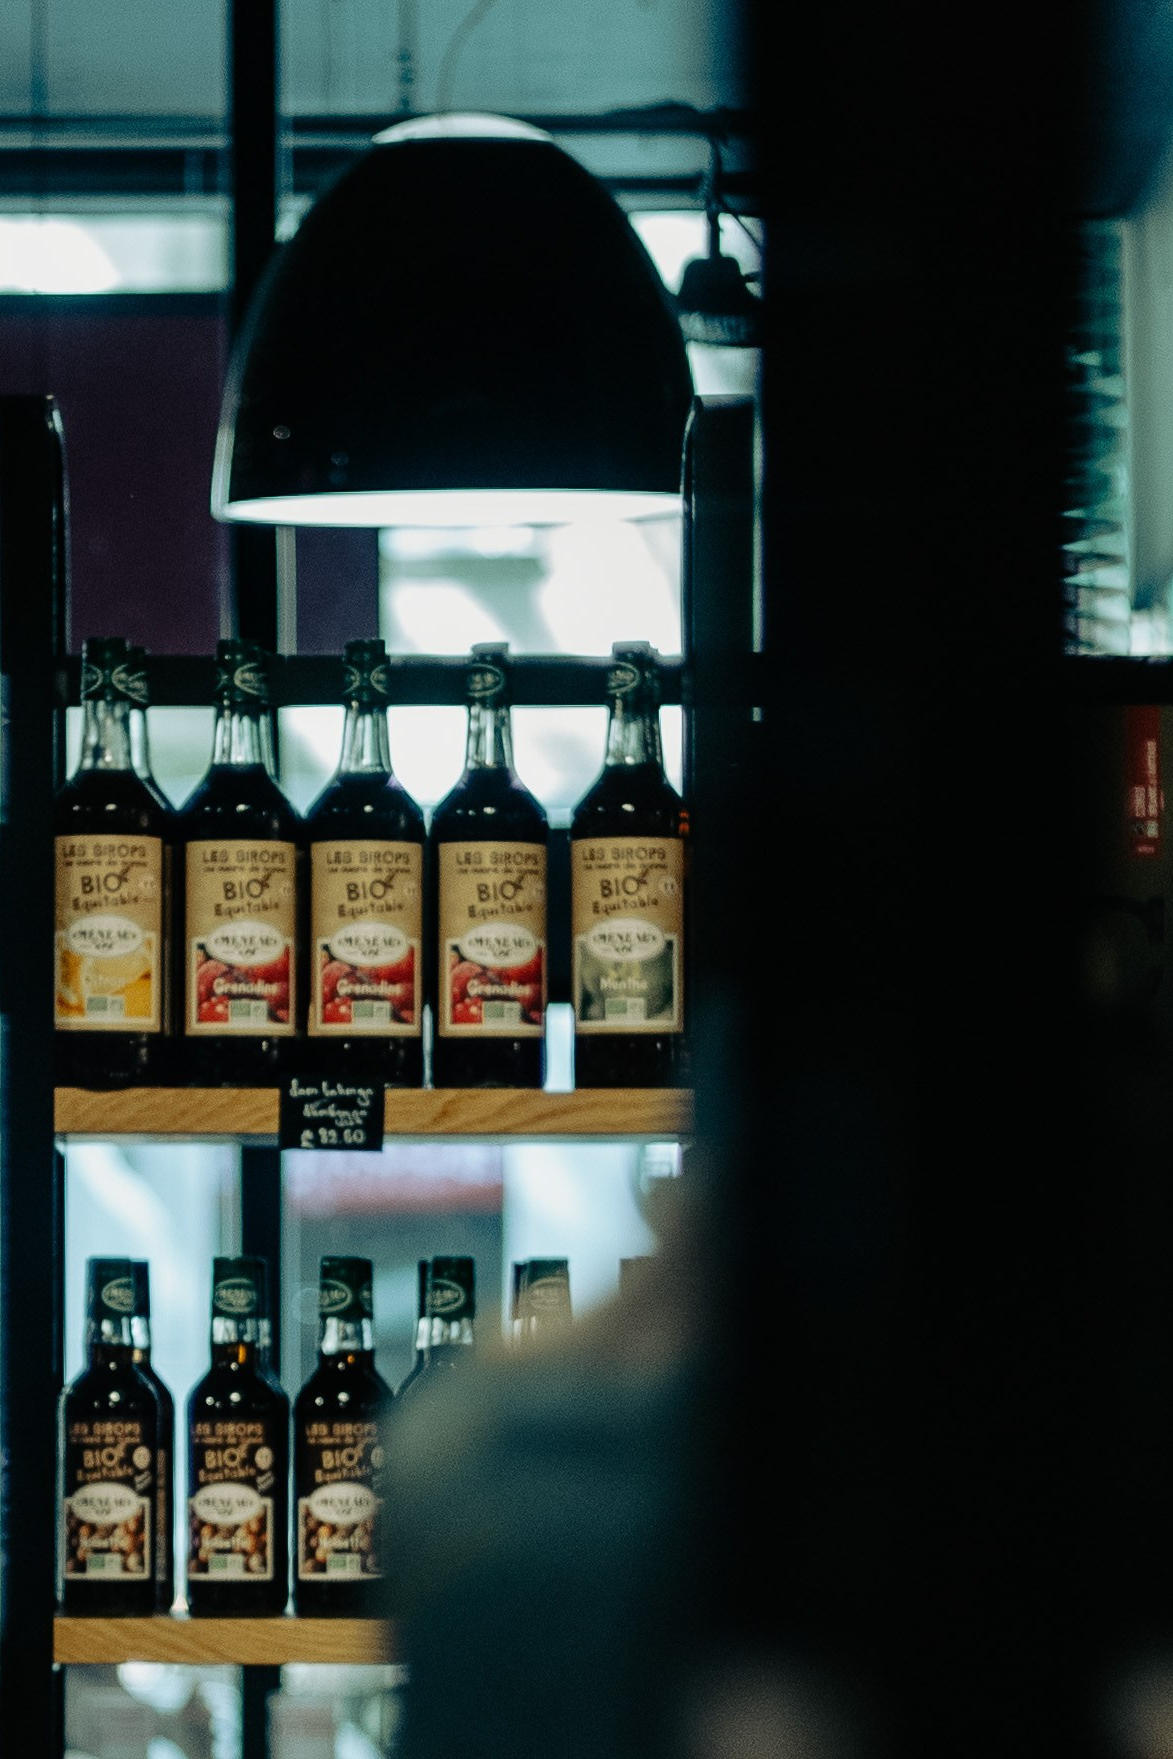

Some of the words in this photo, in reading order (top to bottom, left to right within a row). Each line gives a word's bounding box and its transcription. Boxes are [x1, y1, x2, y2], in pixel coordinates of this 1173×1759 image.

[93, 844, 147, 858] SIROPS
[236, 849, 287, 863] SIROPS
[359, 851, 411, 865] SIROPS
[489, 851, 539, 865] SIROPS
[611, 847, 666, 861] SIROPS
[81, 871, 123, 894] BIO
[222, 878, 264, 900] BIO
[346, 878, 388, 901] BIO
[476, 880, 518, 902] BIO
[600, 875, 639, 898] BIO
